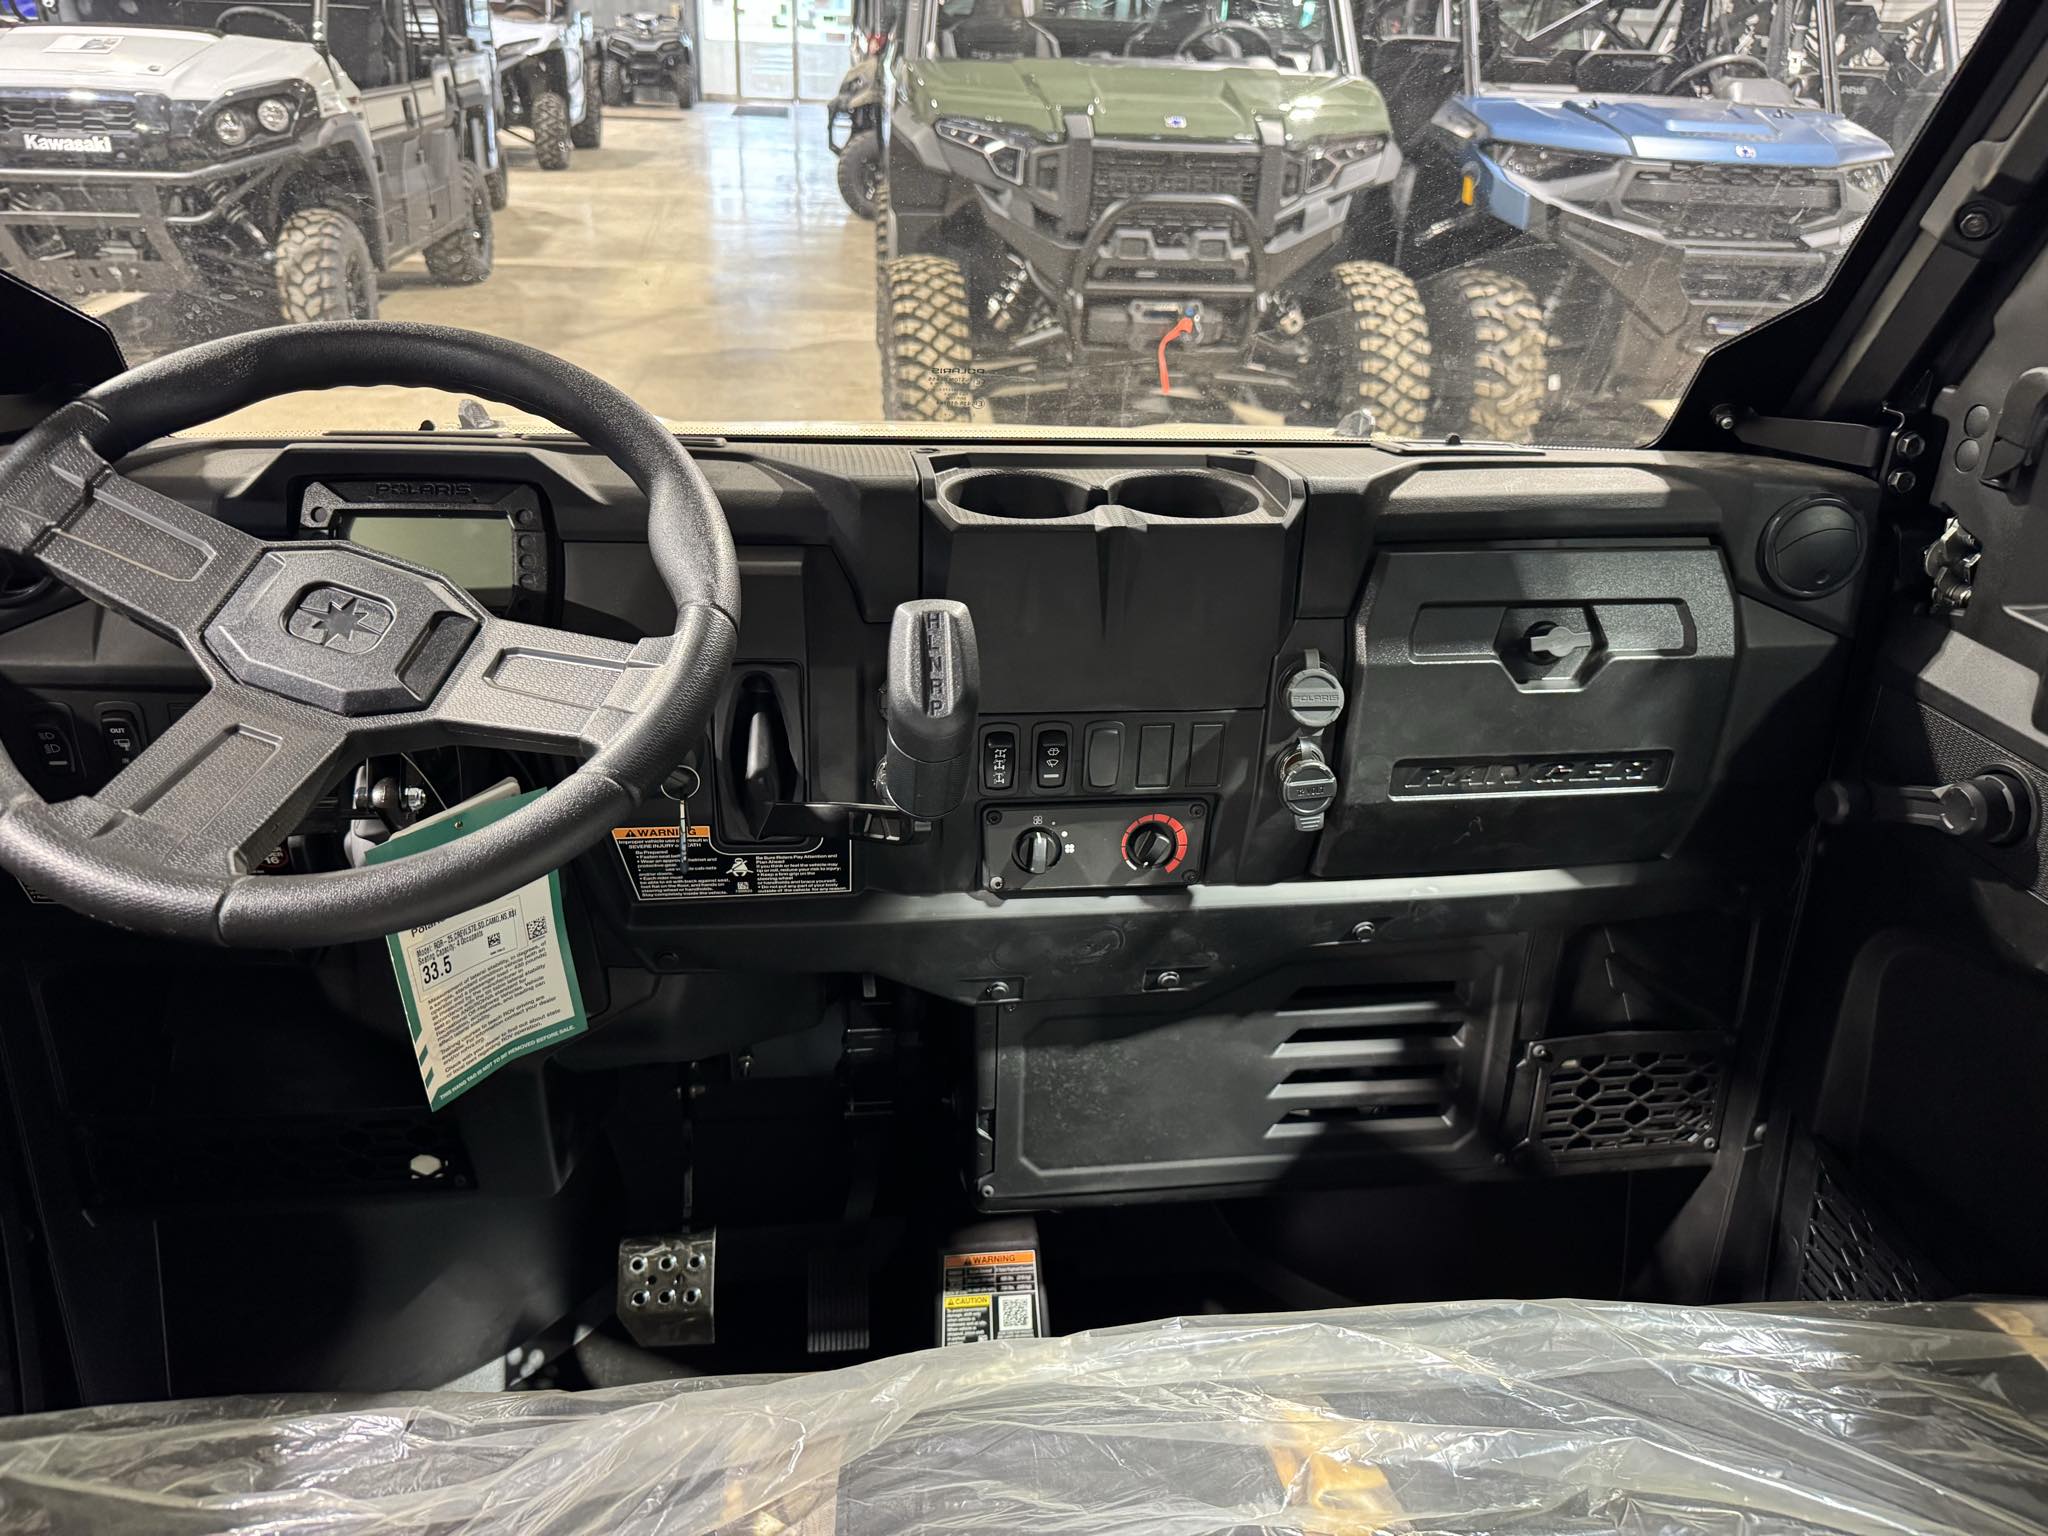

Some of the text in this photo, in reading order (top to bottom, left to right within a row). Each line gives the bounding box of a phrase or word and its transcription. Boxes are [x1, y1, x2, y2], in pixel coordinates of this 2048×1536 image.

[24, 134, 112, 152] Kawasaki
[376, 482, 472, 496] POLARIS
[1403, 762, 1651, 788] RANGER
[638, 828, 696, 836] WARNIG
[423, 954, 452, 984] 33.5
[440, 1090, 452, 1100] THIS
[508, 1040, 536, 1055] REMOVED
[536, 1032, 559, 1044] BEFORE
[559, 1024, 576, 1035] SALE.
[973, 1255, 1016, 1264] WARNING
